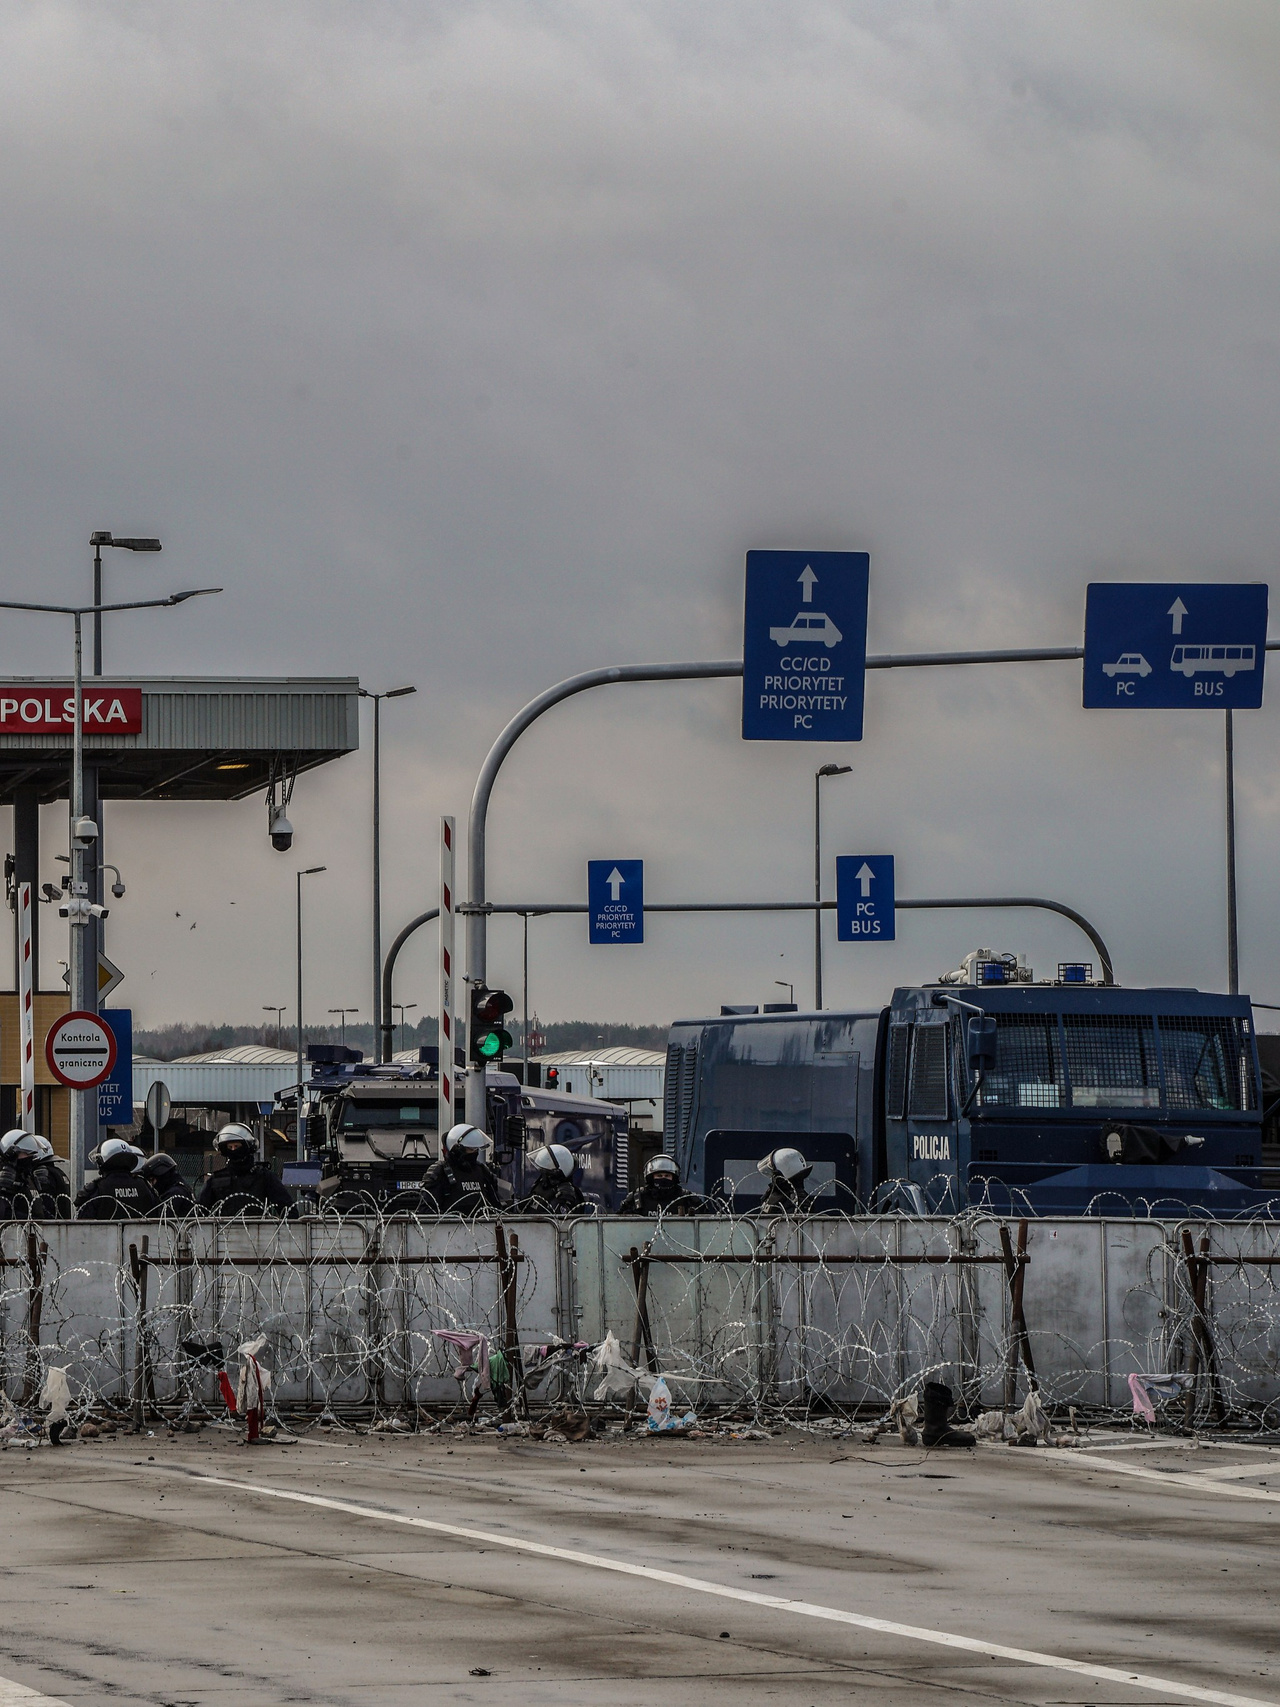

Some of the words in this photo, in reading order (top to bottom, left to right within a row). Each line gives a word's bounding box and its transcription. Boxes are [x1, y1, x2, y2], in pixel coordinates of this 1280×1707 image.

[780, 657, 831, 671] CC/CD
[764, 676, 844, 691] PRIORYTET
[1116, 681, 1135, 695] PC
[1194, 682, 1224, 695] BUS
[760, 695, 847, 710] PRIORYTETY
[0, 698, 128, 723] POLSKA
[794, 715, 812, 728] PC
[856, 902, 875, 916] PC
[597, 913, 635, 921] PRIORYTET
[595, 921, 636, 929] PRIORYTETY
[851, 920, 881, 934] BUS
[611, 930, 621, 938] PC
[61, 1033, 100, 1042] Kontrola
[59, 1058, 104, 1070] graniczna
[913, 1135, 950, 1160] POLICJA
[114, 1187, 139, 1197] POLICJA
[461, 1181, 481, 1191] POLICJA
